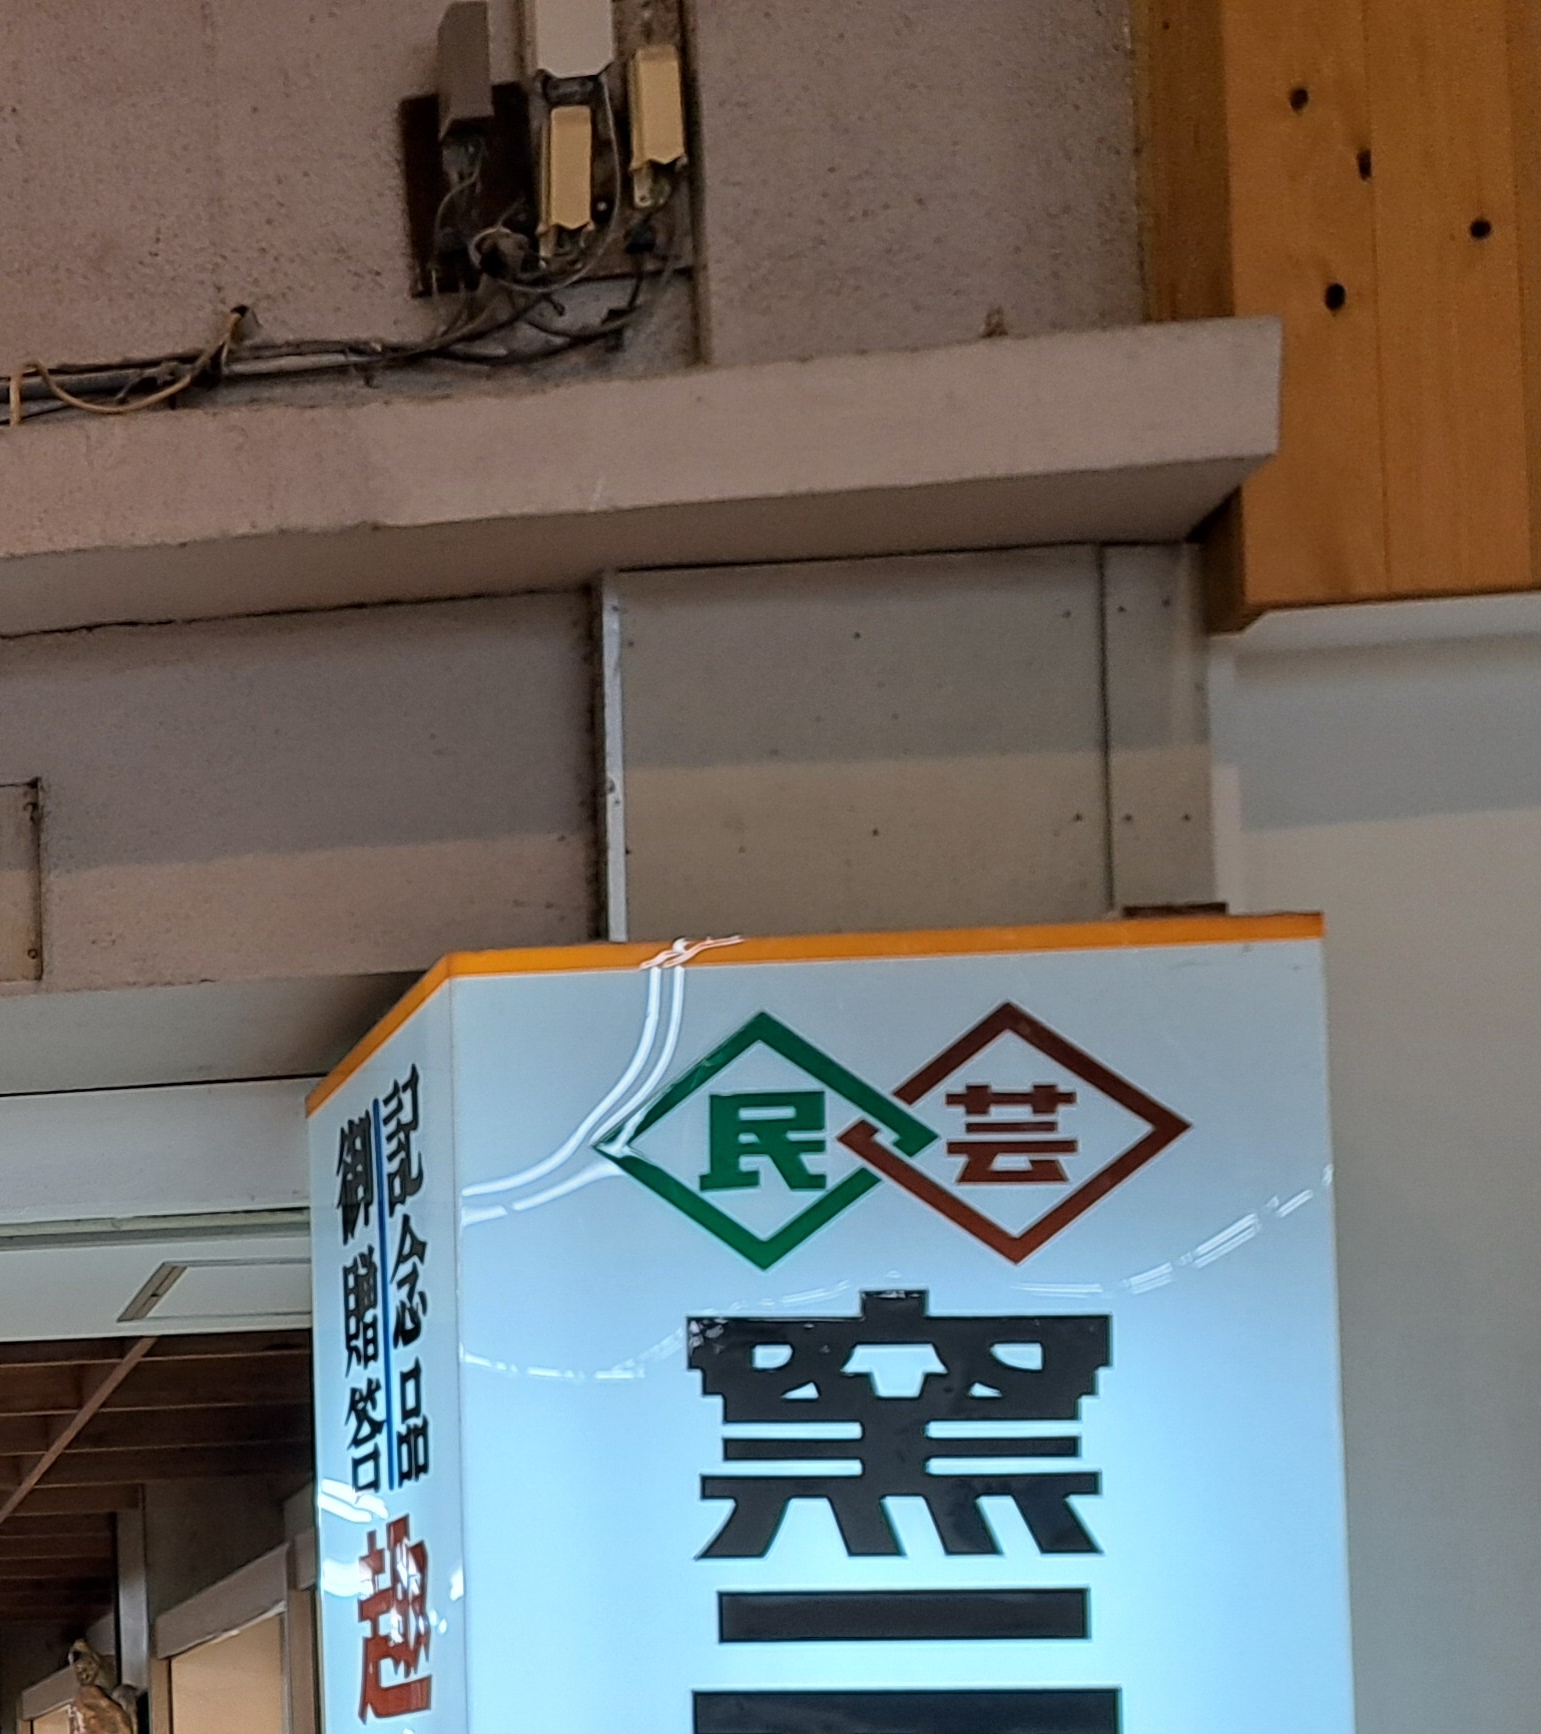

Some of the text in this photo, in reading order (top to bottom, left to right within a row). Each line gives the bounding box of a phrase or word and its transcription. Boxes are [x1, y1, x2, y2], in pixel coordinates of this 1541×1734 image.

[336, 1109, 387, 1494] 御贈答
[383, 1063, 430, 1489] 記念品
[700, 1084, 1077, 1193] 民芸
